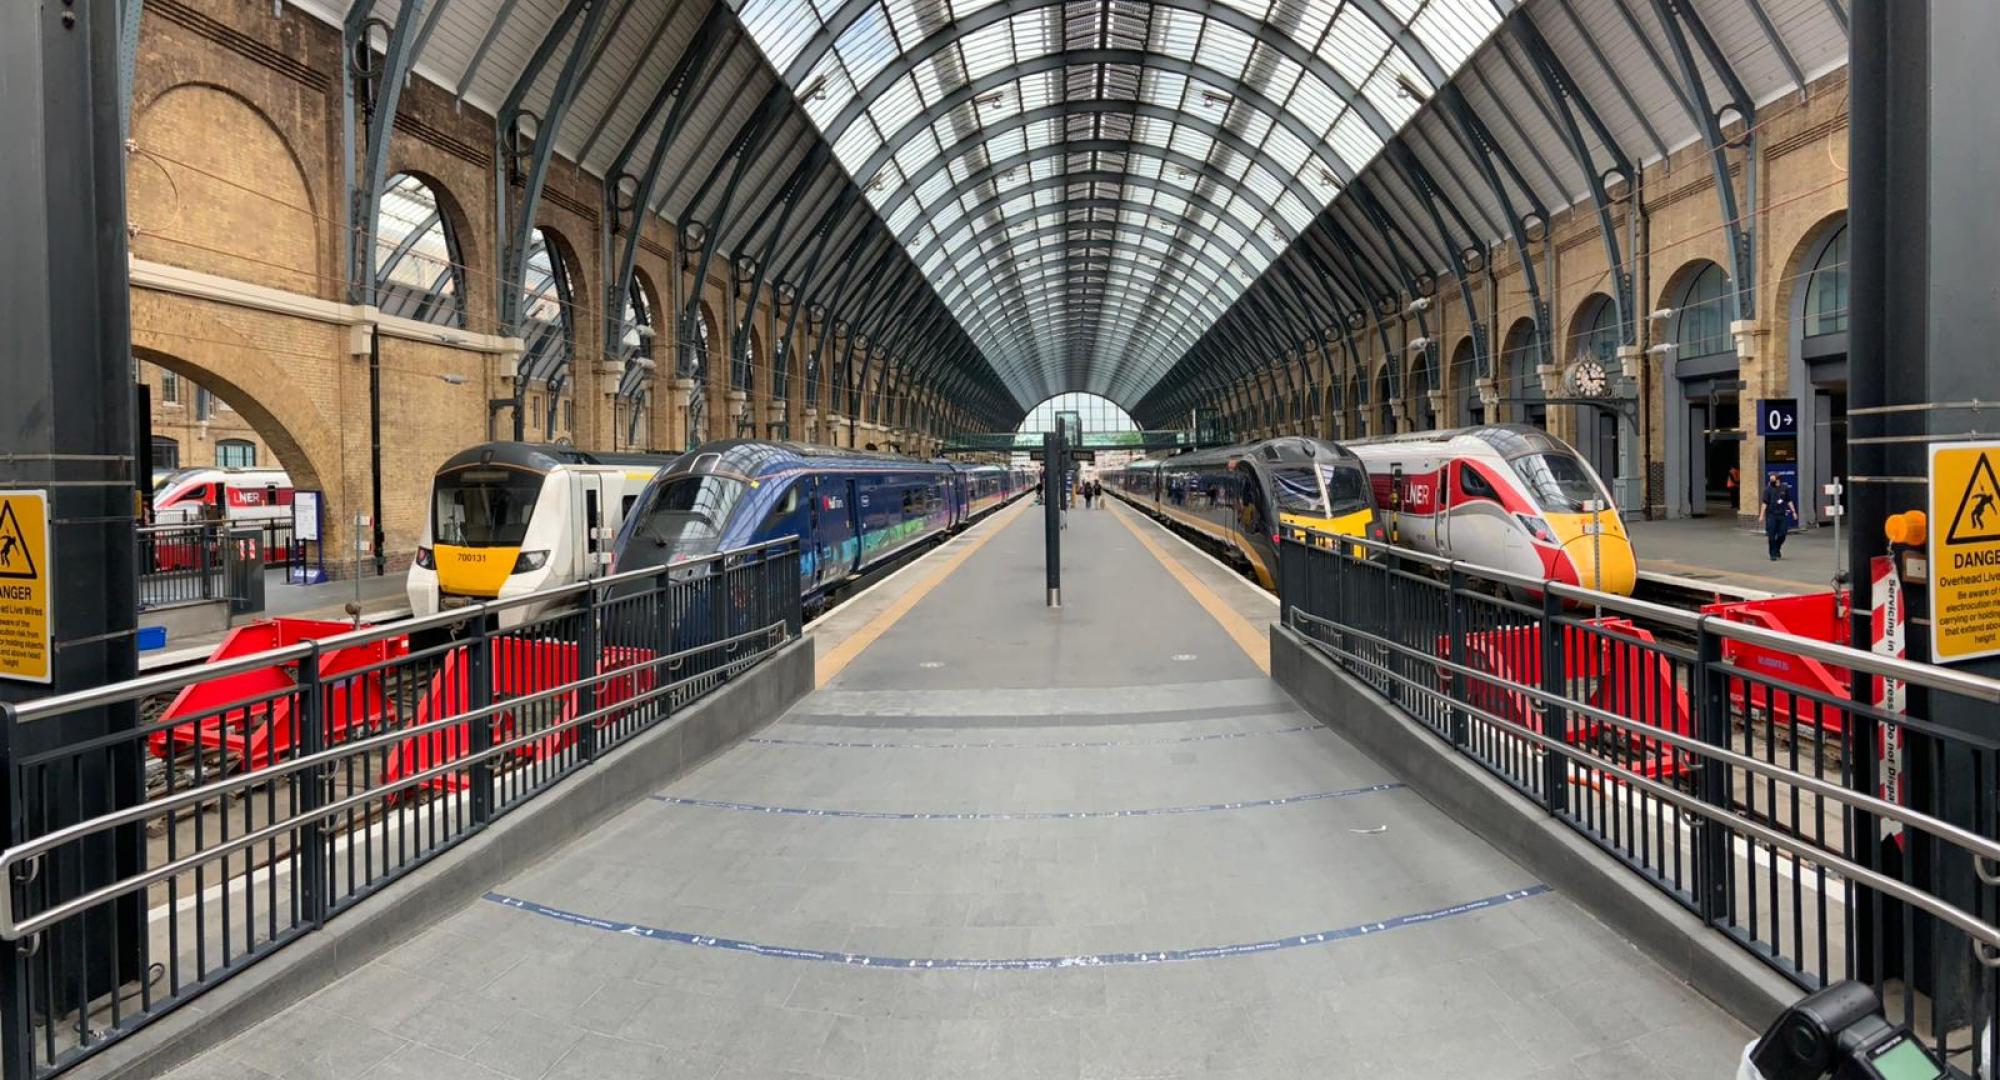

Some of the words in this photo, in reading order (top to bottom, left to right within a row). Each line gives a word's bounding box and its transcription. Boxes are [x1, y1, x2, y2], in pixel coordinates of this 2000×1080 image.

[1769, 409, 1781, 430] 0
[232, 491, 260, 505] LNER
[1404, 480, 1430, 506] LNER
[457, 553, 486, 562] 700131
[1939, 573, 1982, 588] Overhead
[1968, 588, 1990, 598] aware
[1886, 579, 1896, 637] Servicing
[1939, 614, 1968, 626] carrying
[1945, 626, 1960, 636] that
[1888, 637, 1895, 651] in
[1887, 743, 1896, 763] not
